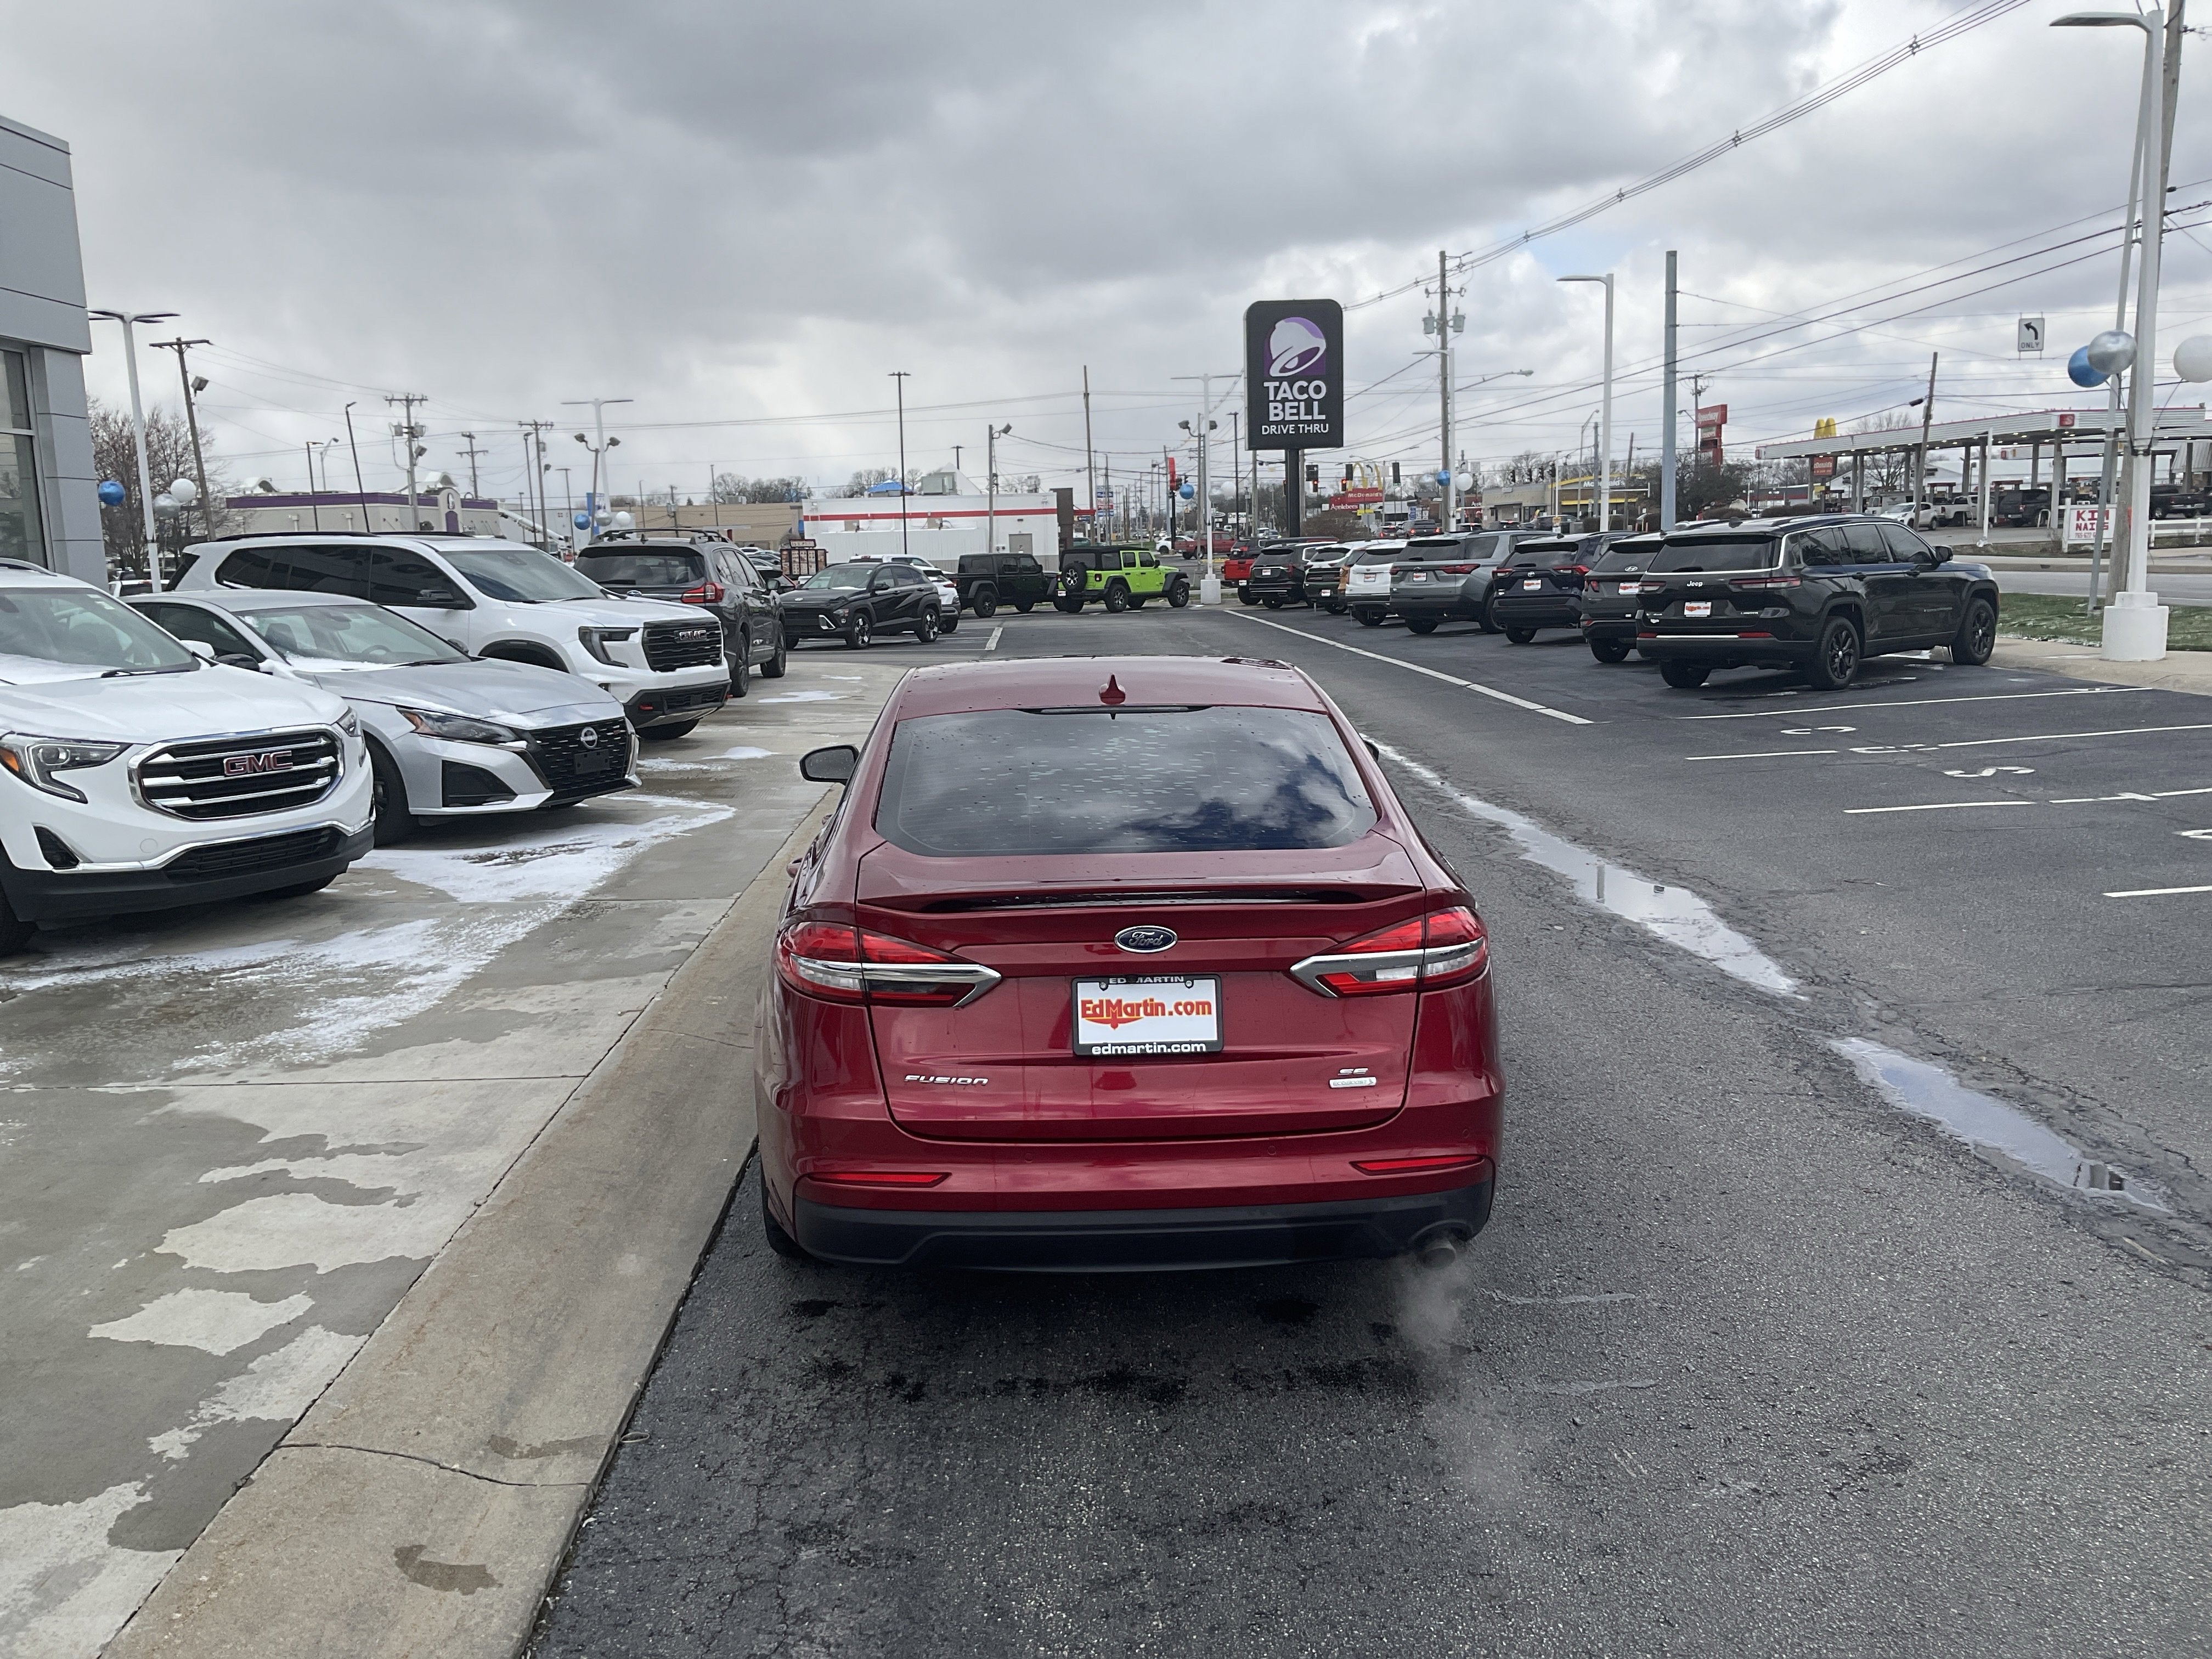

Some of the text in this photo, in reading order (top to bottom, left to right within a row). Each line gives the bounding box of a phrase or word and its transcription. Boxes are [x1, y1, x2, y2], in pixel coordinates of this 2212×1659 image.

[1263, 380, 1327, 400] TACO
[1269, 401, 1326, 421] BELL
[1262, 424, 1329, 435] DRIVE THRU
[2075, 522, 2109, 531] NAIS
[679, 630, 707, 640] GMC
[223, 751, 293, 775] GMC
[1128, 932, 1164, 946] Ford
[1081, 998, 1212, 1022] EdMartin.com
[1092, 1042, 1206, 1054] edmartin.com
[1338, 1068, 1368, 1076] SE
[905, 1075, 988, 1085] FUSION
